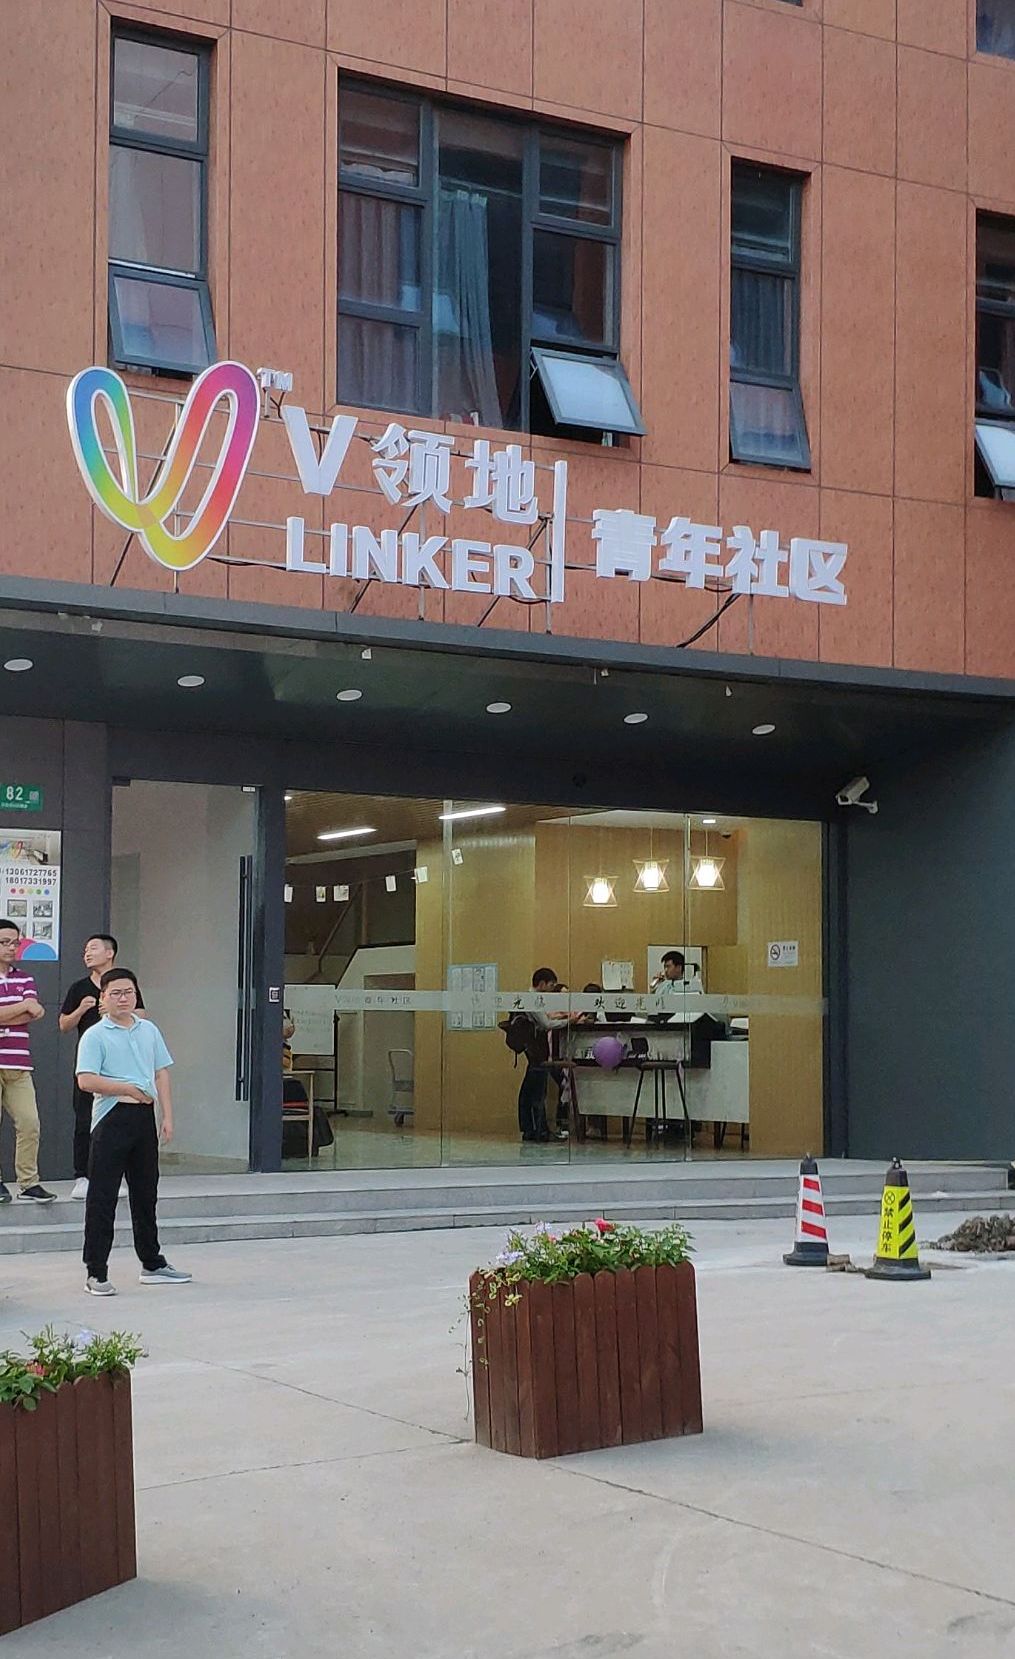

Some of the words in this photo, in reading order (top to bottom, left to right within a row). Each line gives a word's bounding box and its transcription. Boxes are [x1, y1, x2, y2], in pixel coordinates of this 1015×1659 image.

[286, 516, 537, 599] LINKER
[591, 508, 849, 606] 青年社区
[6, 785, 24, 801] 82
[881, 1206, 894, 1253] 禁止停车
